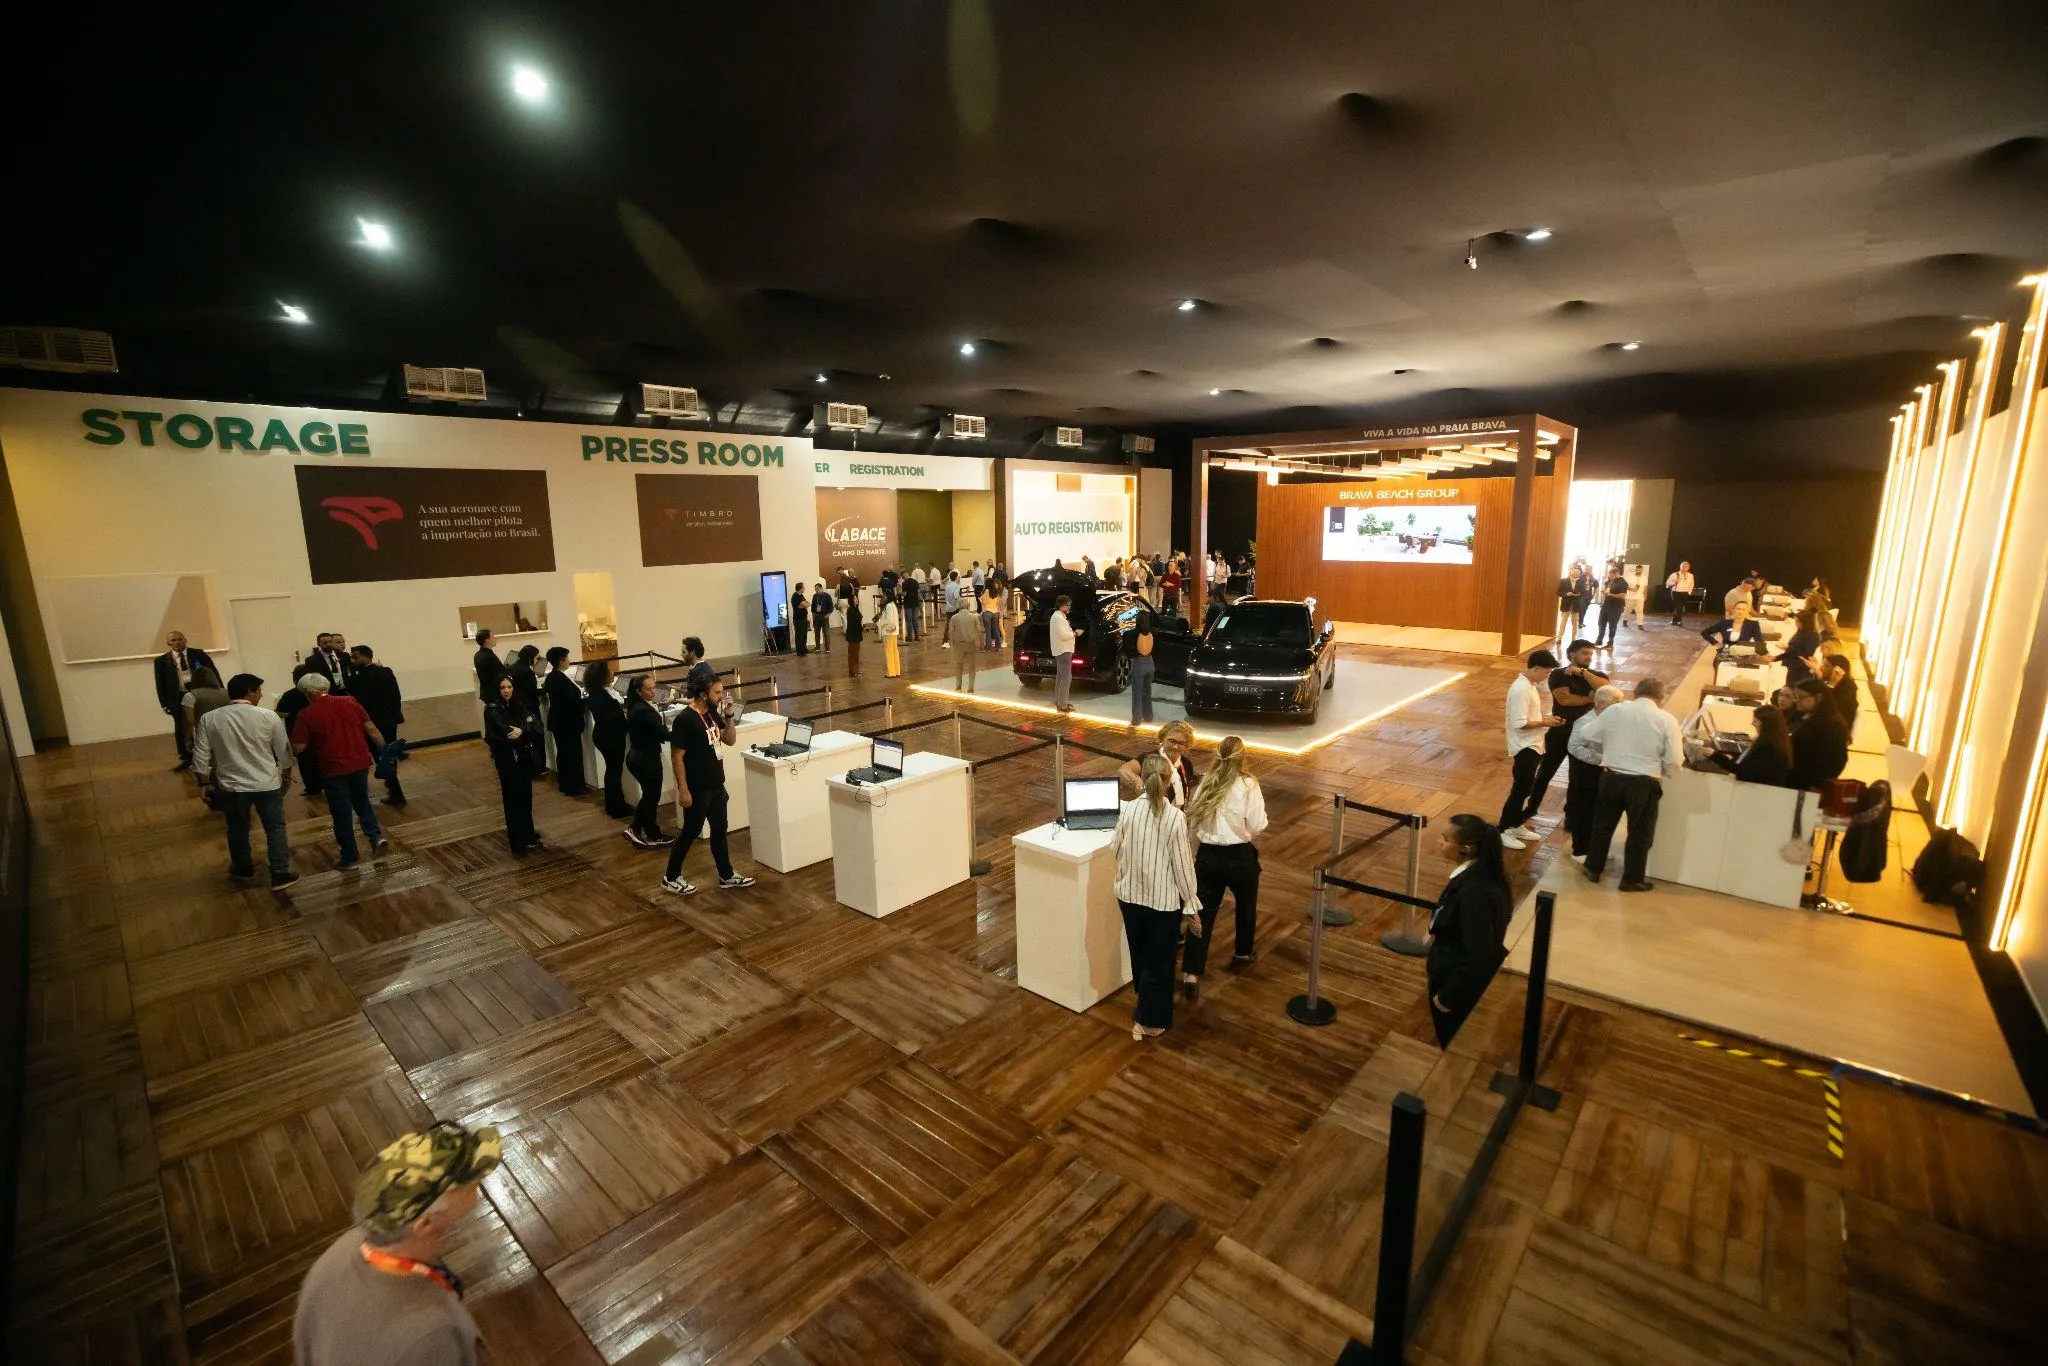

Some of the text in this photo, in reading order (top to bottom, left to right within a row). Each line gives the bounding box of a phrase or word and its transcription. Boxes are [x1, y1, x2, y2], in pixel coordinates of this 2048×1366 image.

[82, 408, 371, 455] STORAGE
[1397, 428, 1420, 436] VIDA
[1422, 425, 1437, 434] NA
[1440, 424, 1469, 433] PRAIA
[1471, 420, 1506, 430] BRAVA
[581, 435, 784, 467] PRESS ROOM
[850, 464, 924, 476] REGISTRATION
[1340, 489, 1459, 500] BRAVA BEACH GROUP
[418, 504, 521, 514] A sua aeronave com
[685, 510, 733, 518] TIMBRO
[420, 515, 523, 528] quem melhor pilota
[1014, 521, 1122, 535] AUTO REGISTRATION
[421, 527, 541, 541] a importação no Brasil.
[831, 527, 887, 543] LABACE
